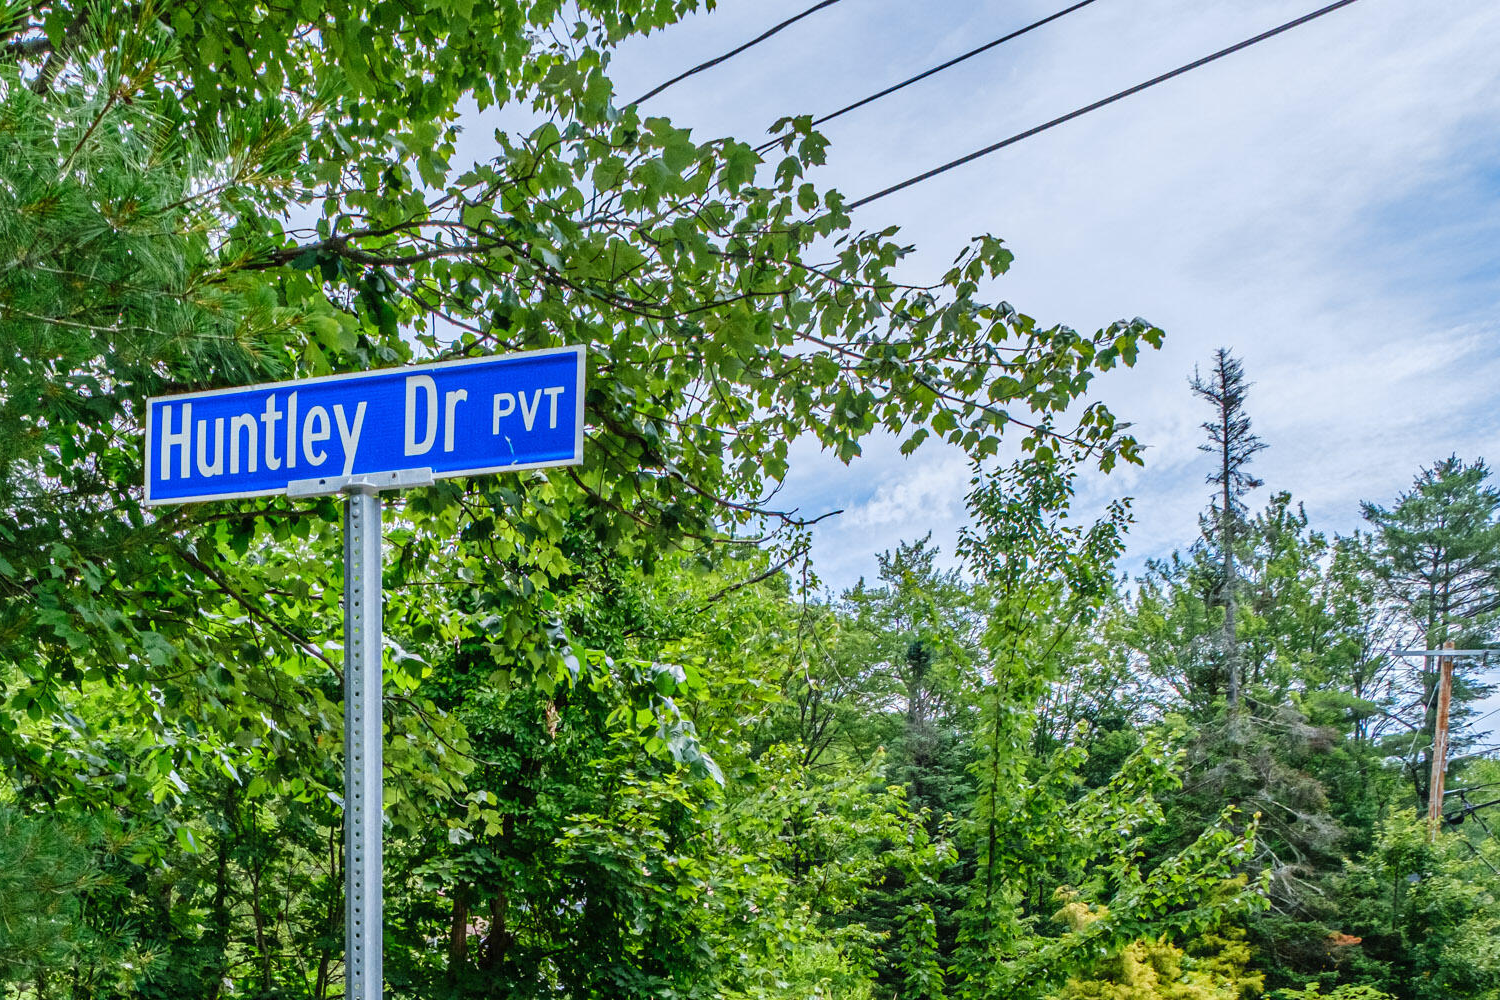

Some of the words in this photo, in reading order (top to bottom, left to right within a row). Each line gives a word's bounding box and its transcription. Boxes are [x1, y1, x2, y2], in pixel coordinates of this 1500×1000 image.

[160, 391, 368, 480] Huntley
[403, 374, 468, 457] Dr
[493, 386, 565, 434] PVT
